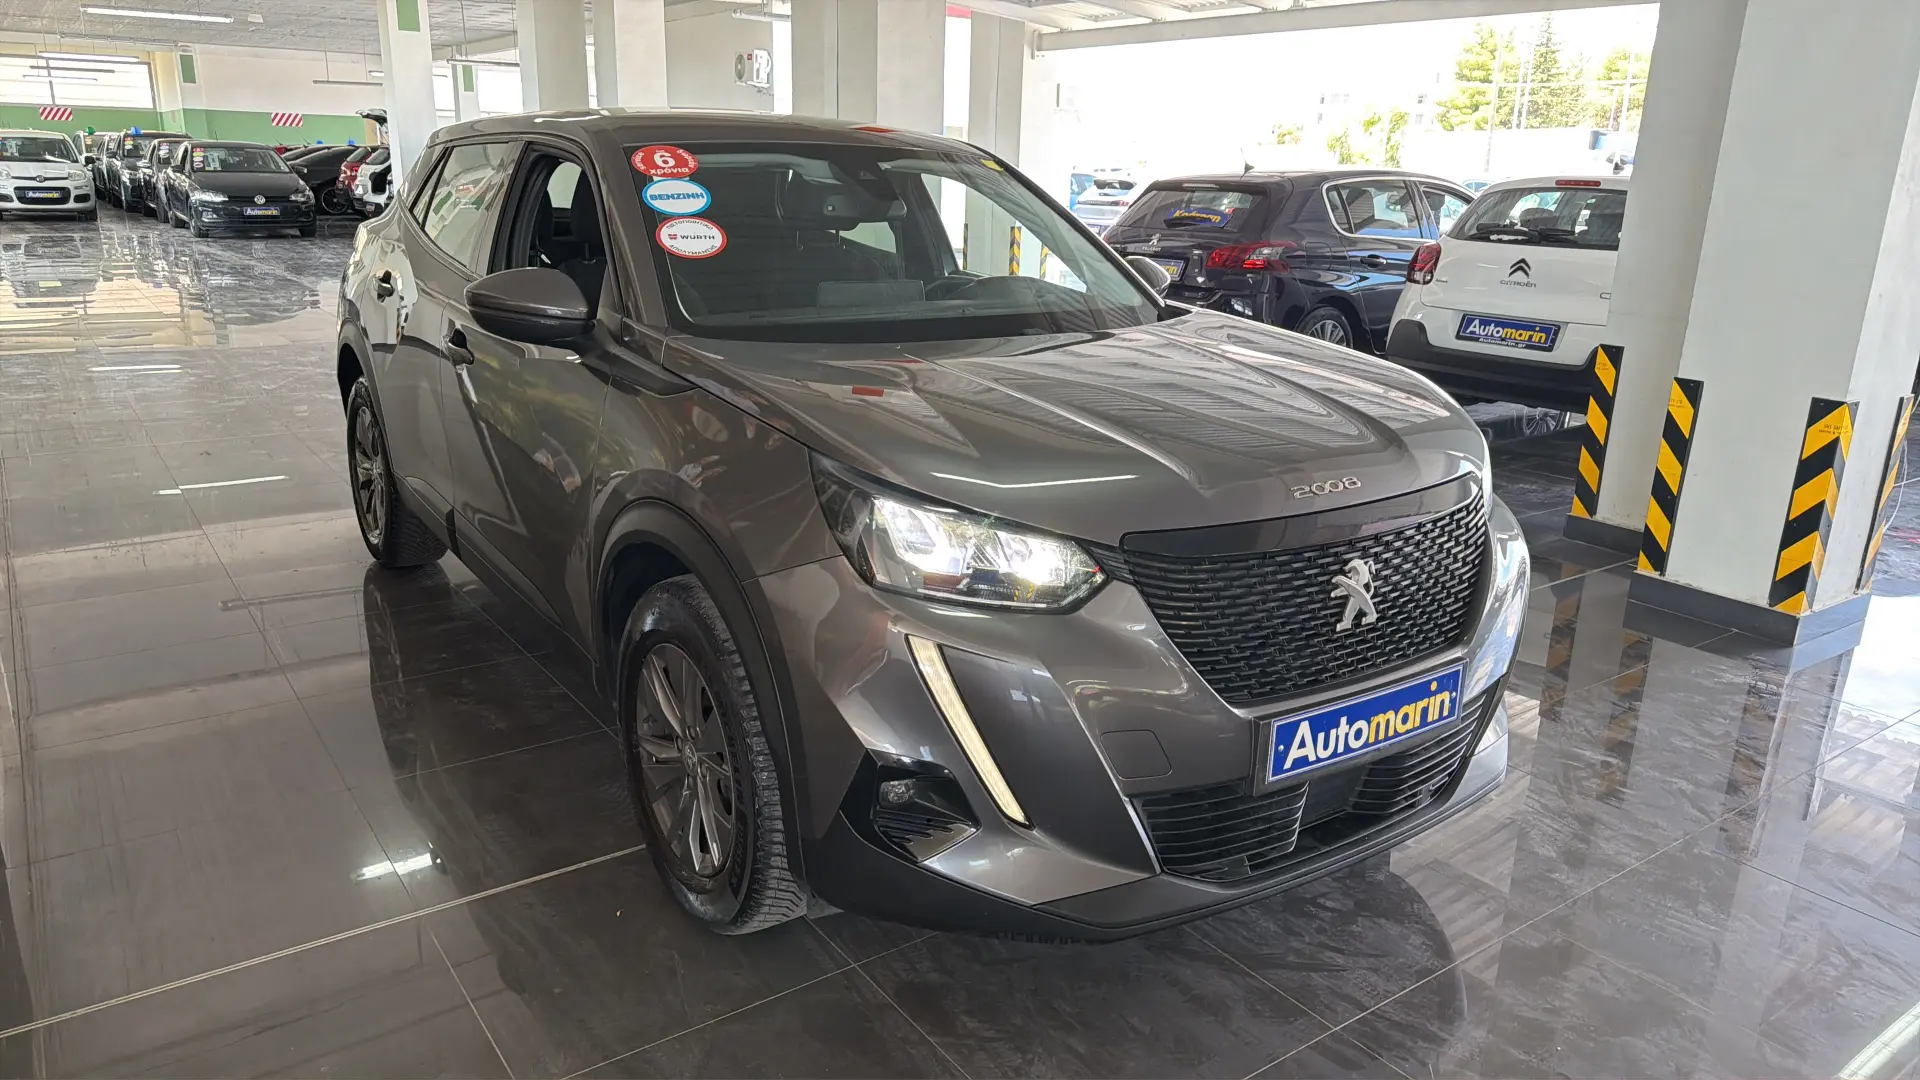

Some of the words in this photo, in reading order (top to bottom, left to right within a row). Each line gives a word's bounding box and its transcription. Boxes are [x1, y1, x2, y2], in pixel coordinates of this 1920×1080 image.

[653, 152, 676, 168] 6
[649, 166, 690, 176] χρόνια
[246, 207, 279, 215] Automarin
[1466, 319, 1546, 344] Automarin
[1479, 337, 1527, 348] Automarin.gr
[1290, 476, 1361, 499] 2008
[1283, 681, 1450, 770] Automarin
